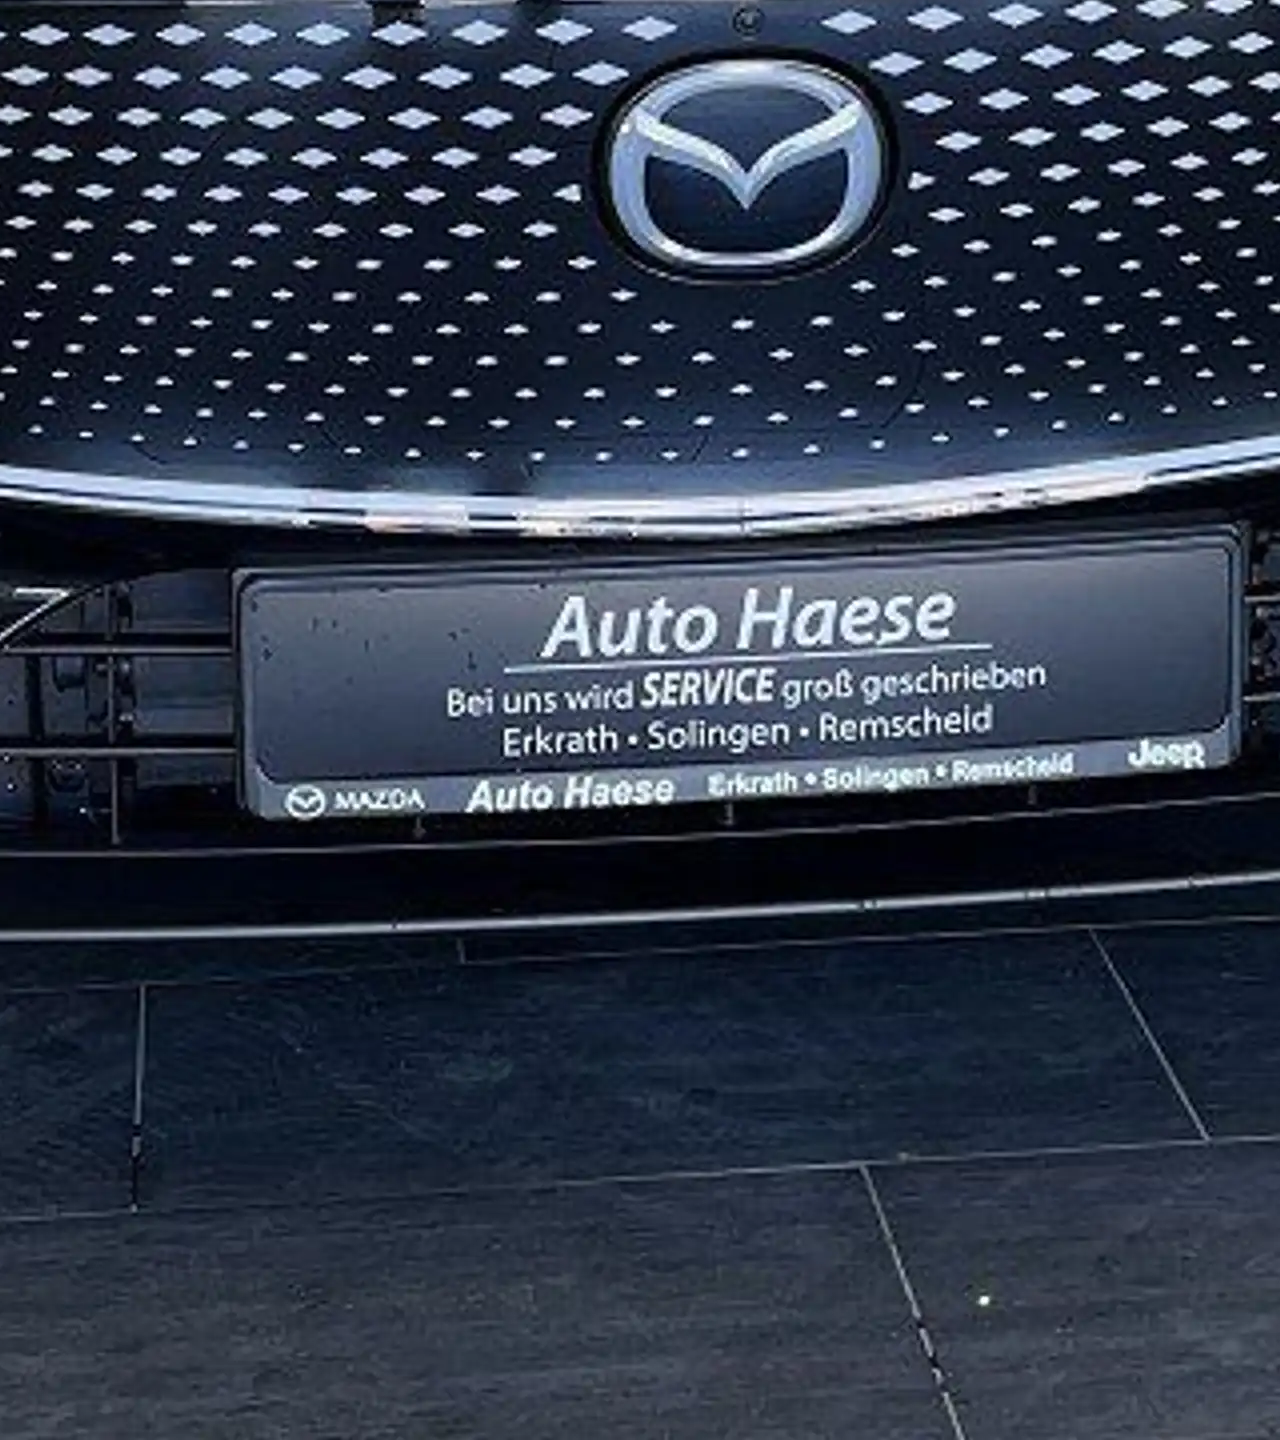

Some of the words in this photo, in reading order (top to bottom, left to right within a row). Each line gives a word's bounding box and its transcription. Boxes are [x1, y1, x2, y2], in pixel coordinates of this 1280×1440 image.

[539, 595, 718, 658] Auto
[736, 587, 957, 651] Haese
[447, 687, 494, 718] Bei
[503, 690, 558, 714] uns
[564, 680, 634, 711] wird
[639, 667, 776, 708] SERVICE
[781, 668, 854, 710] groß
[860, 660, 1047, 706] geschrieben
[503, 723, 618, 758] Erkrath
[647, 718, 790, 754] Solingen
[819, 703, 995, 743] Remscheid
[707, 769, 798, 797] Erkrath
[823, 764, 929, 792] Solingen
[951, 752, 1075, 783] Remscheid
[1128, 738, 1206, 769] Jeep
[334, 787, 426, 811] MAZDA
[464, 779, 554, 813] Auto
[564, 776, 676, 809] Haese
